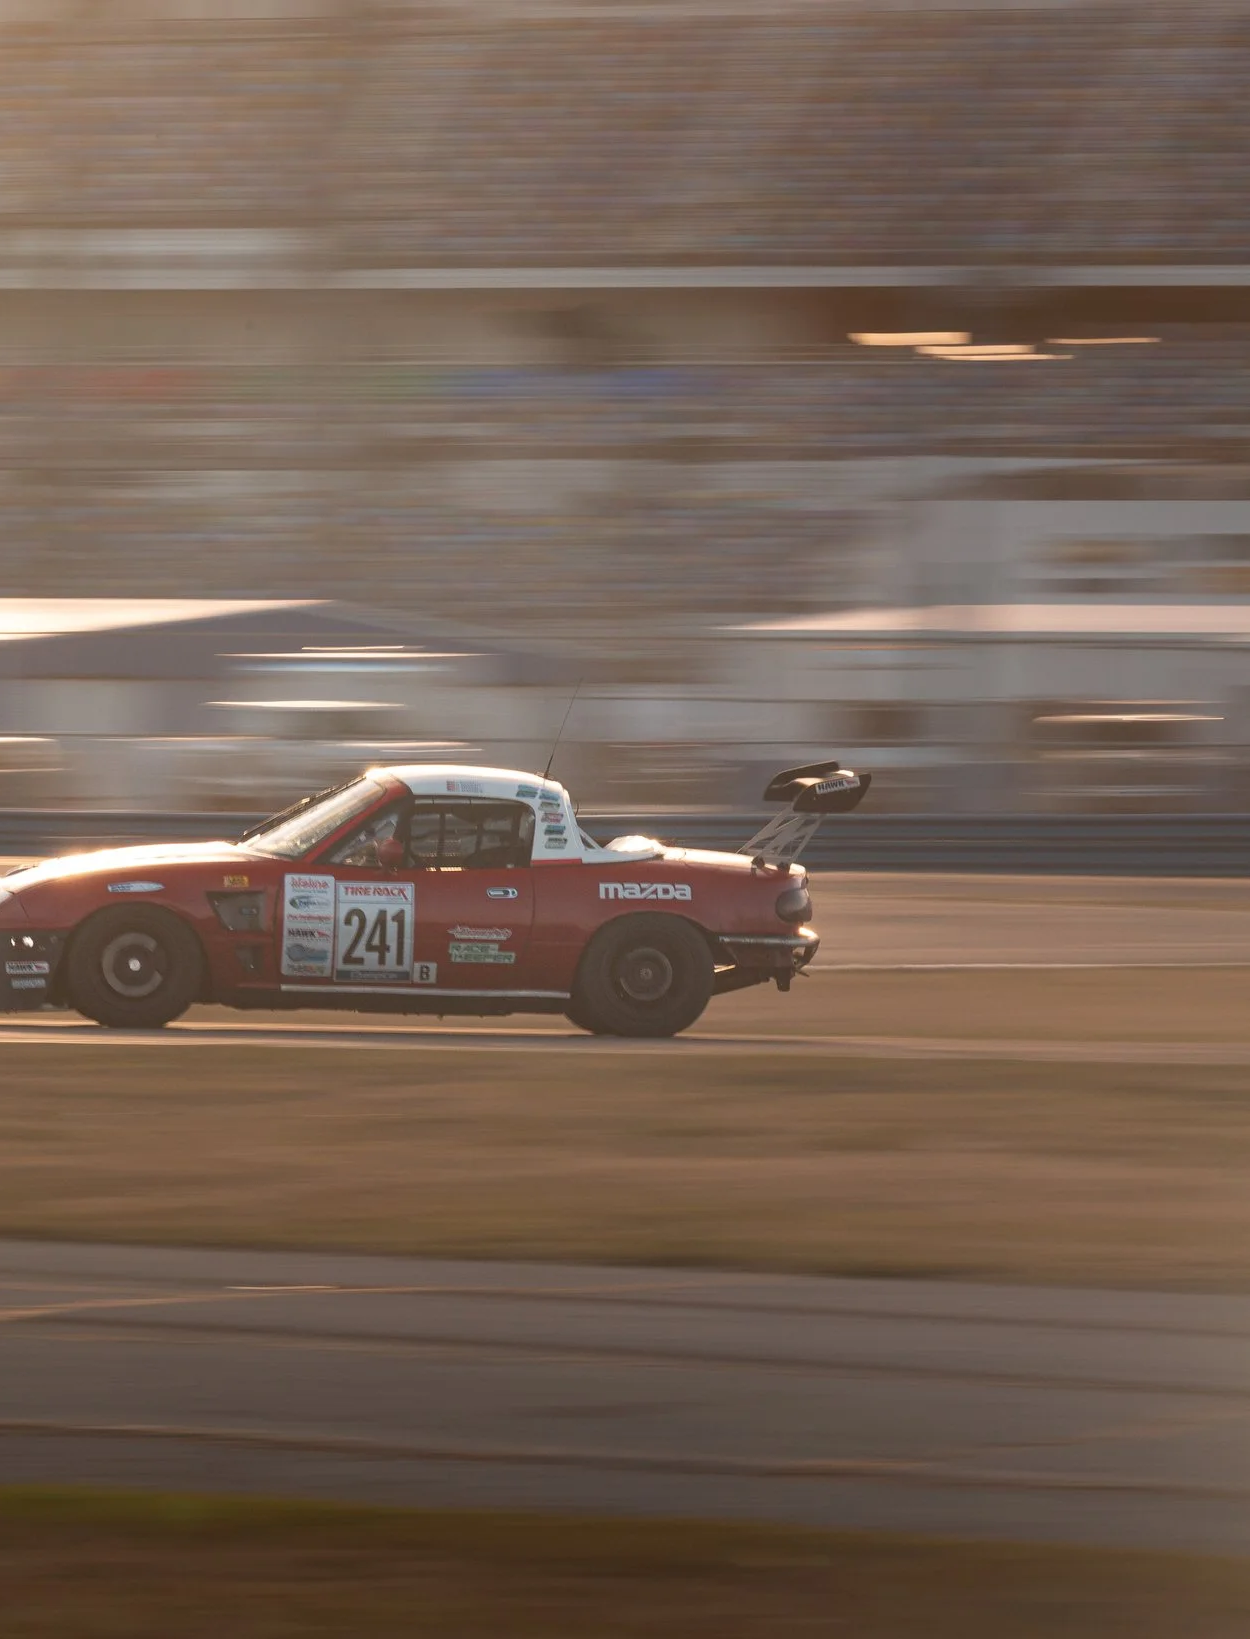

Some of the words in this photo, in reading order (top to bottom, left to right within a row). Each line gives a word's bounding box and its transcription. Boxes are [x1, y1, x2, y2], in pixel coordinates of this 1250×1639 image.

[817, 780, 845, 791] HAWK
[344, 886, 371, 897] TIRE
[373, 886, 409, 901] RACK
[342, 908, 406, 967] 241
[420, 964, 431, 980] B
